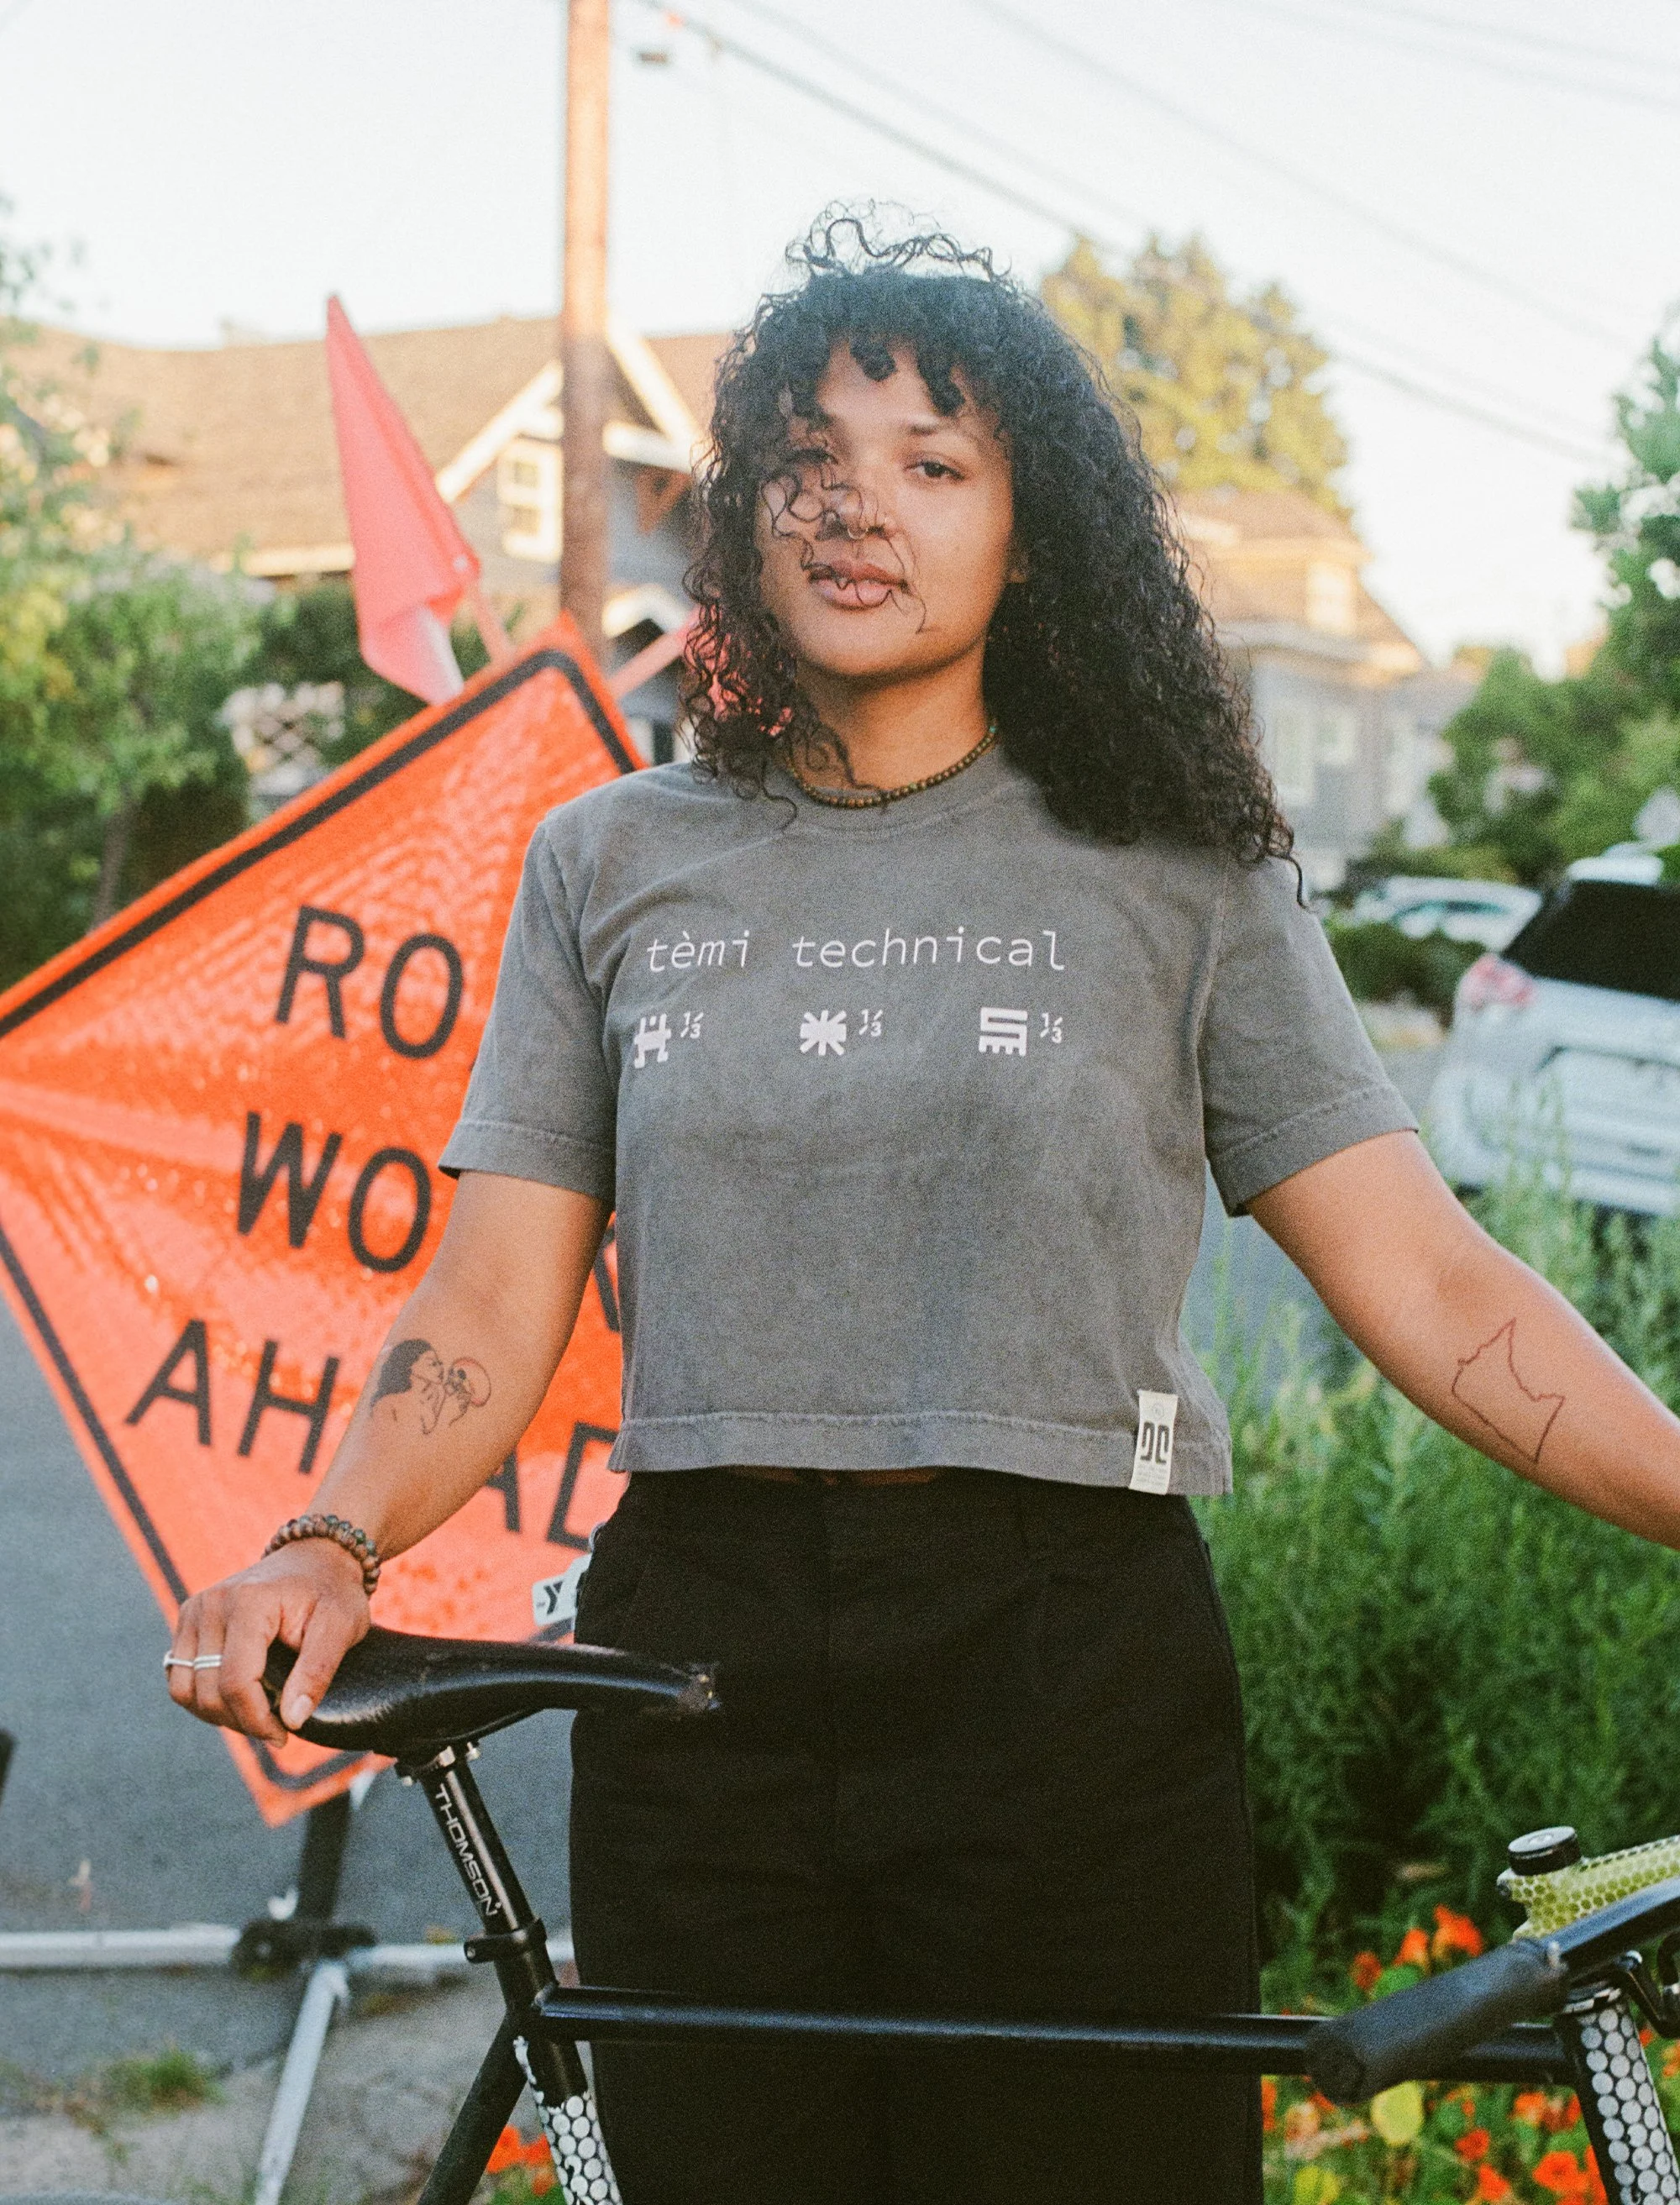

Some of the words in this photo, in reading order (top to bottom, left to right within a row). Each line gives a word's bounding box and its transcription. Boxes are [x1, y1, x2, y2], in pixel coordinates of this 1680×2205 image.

[277, 904, 475, 1072] RO
[645, 931, 749, 972] tèmi
[792, 927, 1065, 970] technical
[124, 1319, 620, 1552] AHD
[435, 1782, 499, 1916] THOMSON
